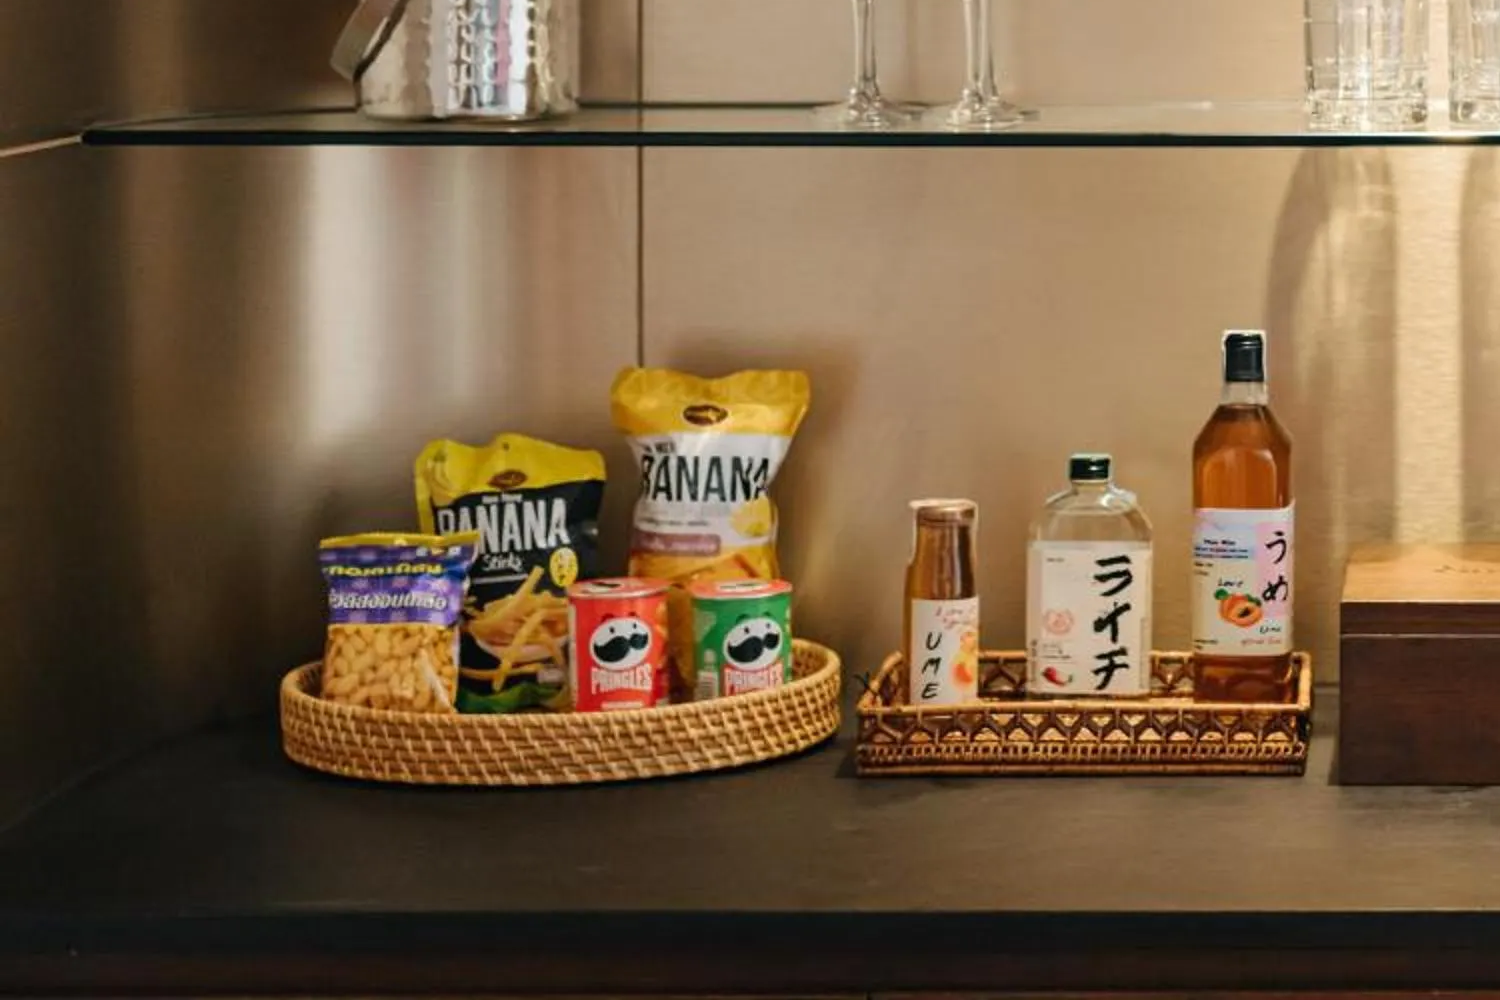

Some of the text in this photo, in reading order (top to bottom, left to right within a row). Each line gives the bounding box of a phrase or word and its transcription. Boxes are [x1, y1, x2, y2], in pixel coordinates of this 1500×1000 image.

[639, 456, 770, 502] BANANA
[437, 498, 571, 554] BANANA
[1261, 530, 1289, 602] うめ
[1091, 554, 1134, 691] ライチ
[590, 663, 653, 695] PRINGLES
[920, 631, 943, 700] UME
